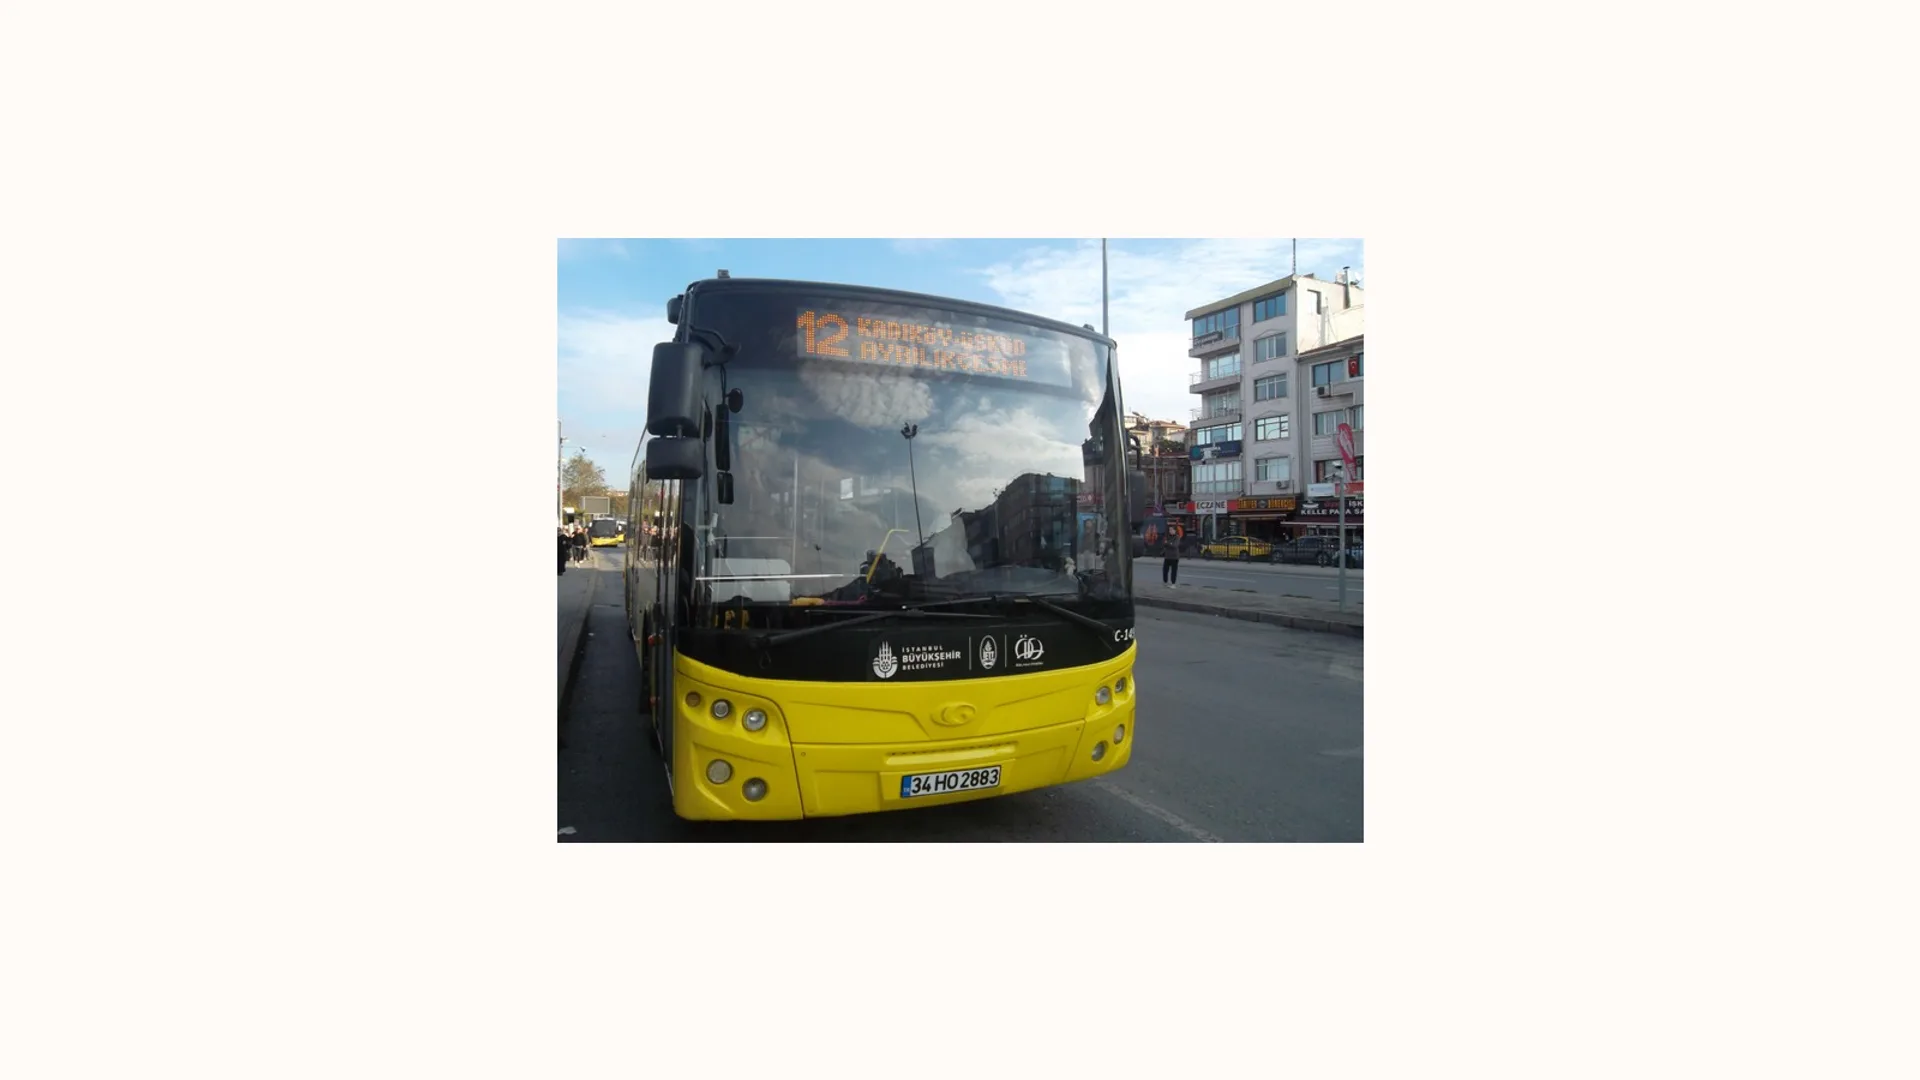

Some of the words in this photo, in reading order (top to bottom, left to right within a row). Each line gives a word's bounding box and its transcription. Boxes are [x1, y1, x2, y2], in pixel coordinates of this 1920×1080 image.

[796, 311, 849, 357] 12
[1196, 501, 1225, 510] ECZANE
[912, 776, 931, 794] 34
[934, 772, 959, 791] HO
[960, 768, 999, 789] 2883
